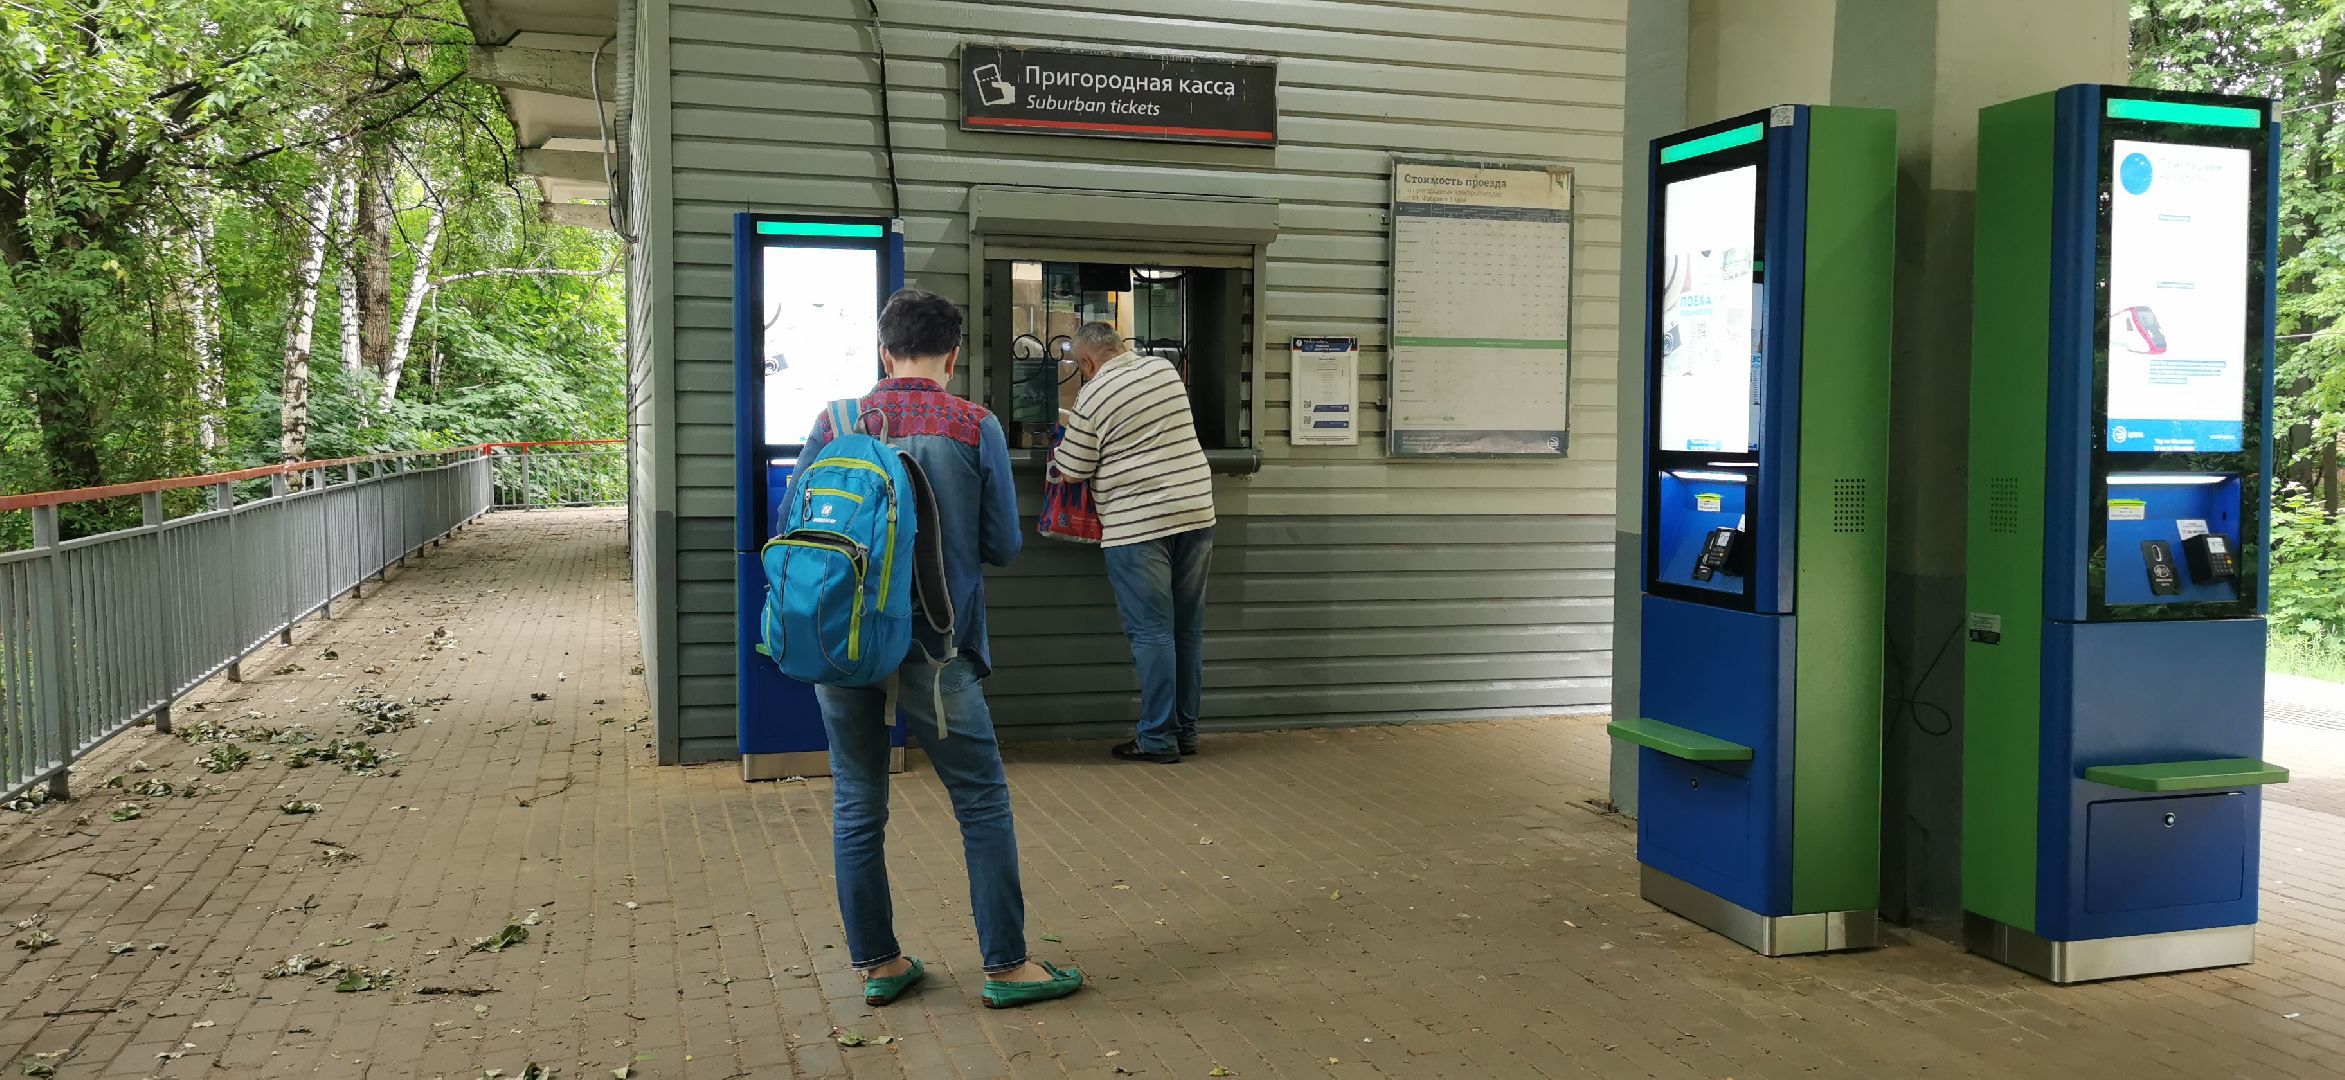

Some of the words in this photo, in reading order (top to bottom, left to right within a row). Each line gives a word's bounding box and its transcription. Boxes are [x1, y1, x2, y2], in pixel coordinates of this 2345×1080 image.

[1026, 65, 1173, 93] Пригородная
[1179, 79, 1235, 96] касса
[1026, 95, 1106, 113] Suburban
[1110, 100, 1161, 116] tickets
[1404, 173, 1463, 186] Стоимость
[1465, 179, 1507, 190] проезда
